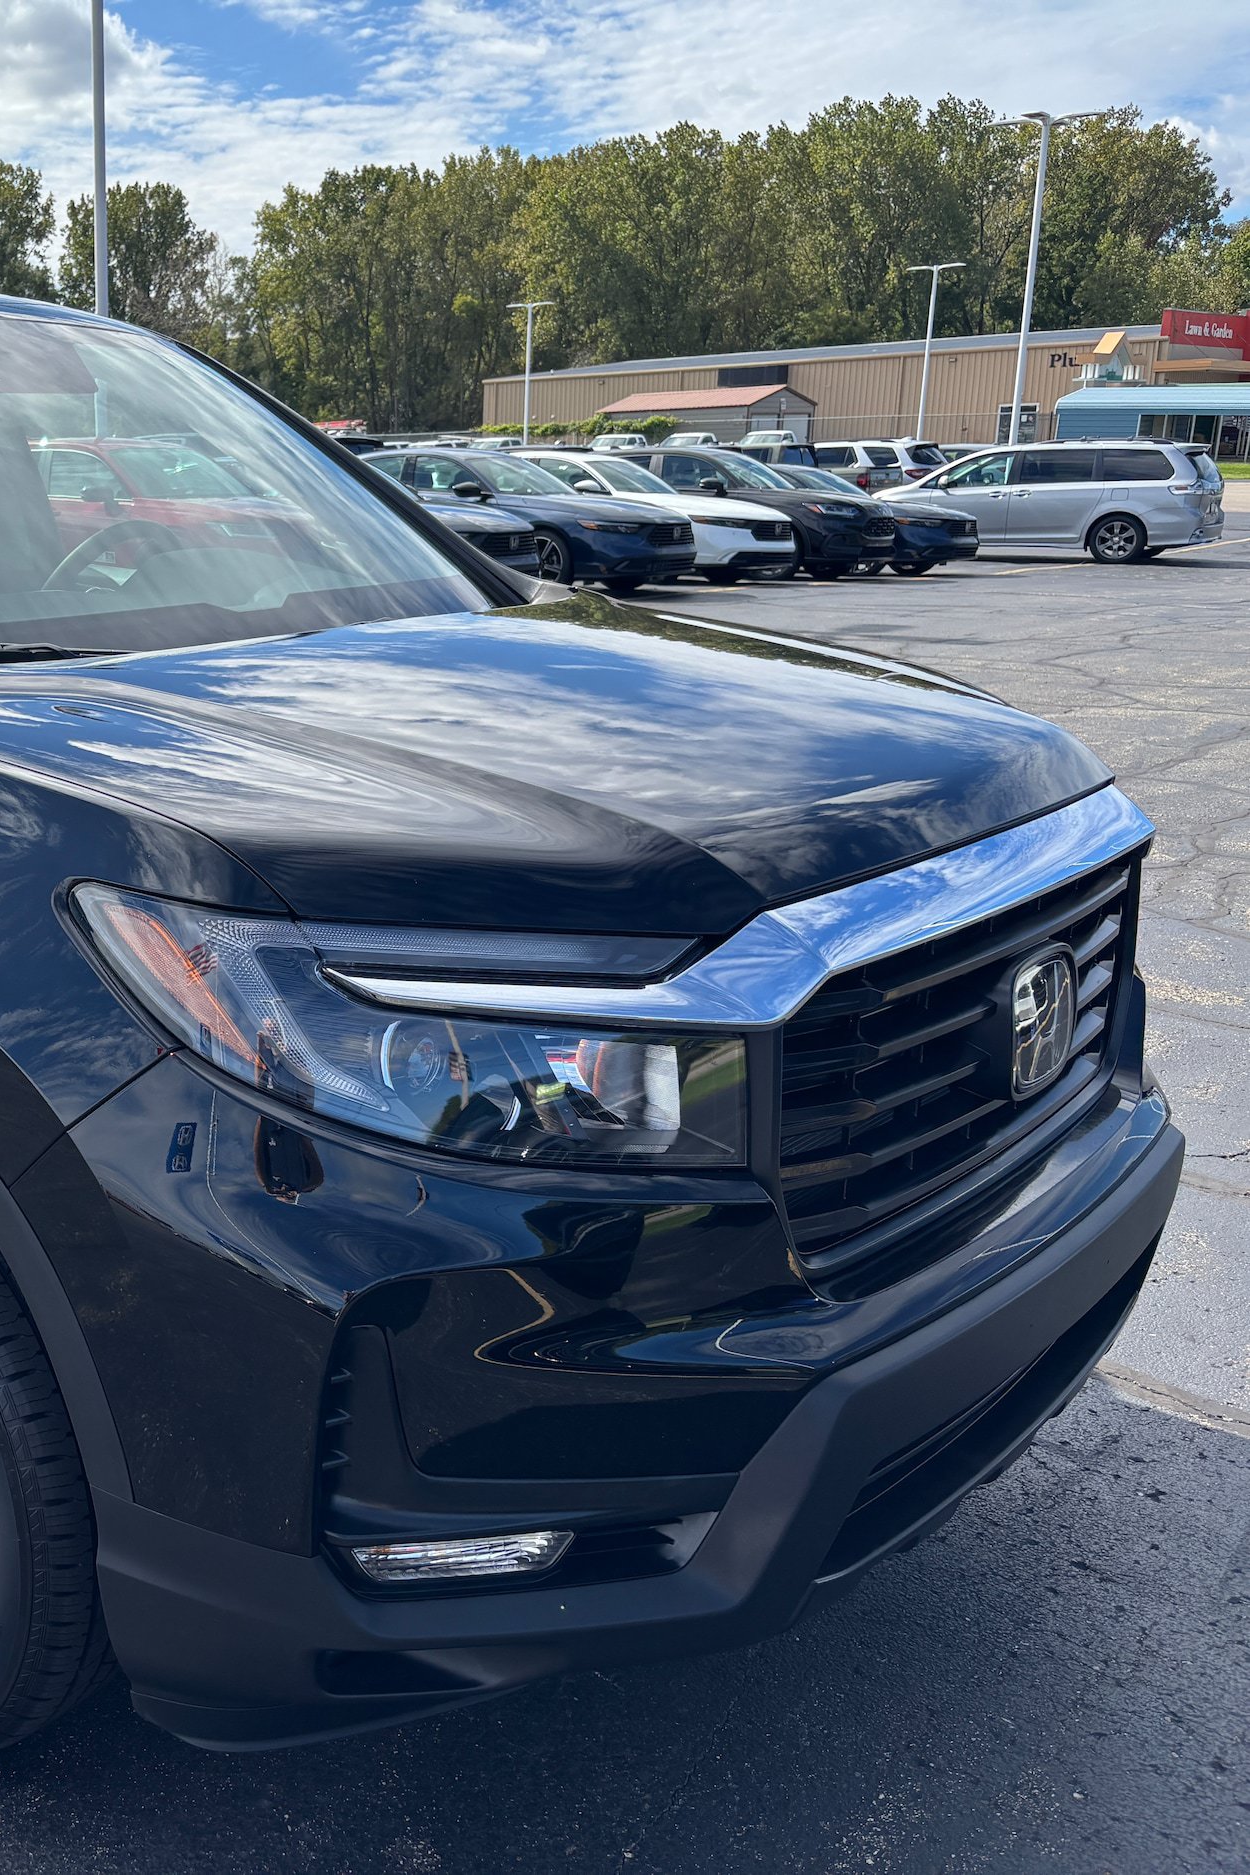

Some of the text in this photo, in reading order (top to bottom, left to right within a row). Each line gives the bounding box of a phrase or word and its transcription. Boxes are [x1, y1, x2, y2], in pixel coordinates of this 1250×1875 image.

[1185, 320, 1233, 339] Lawn & Garden
